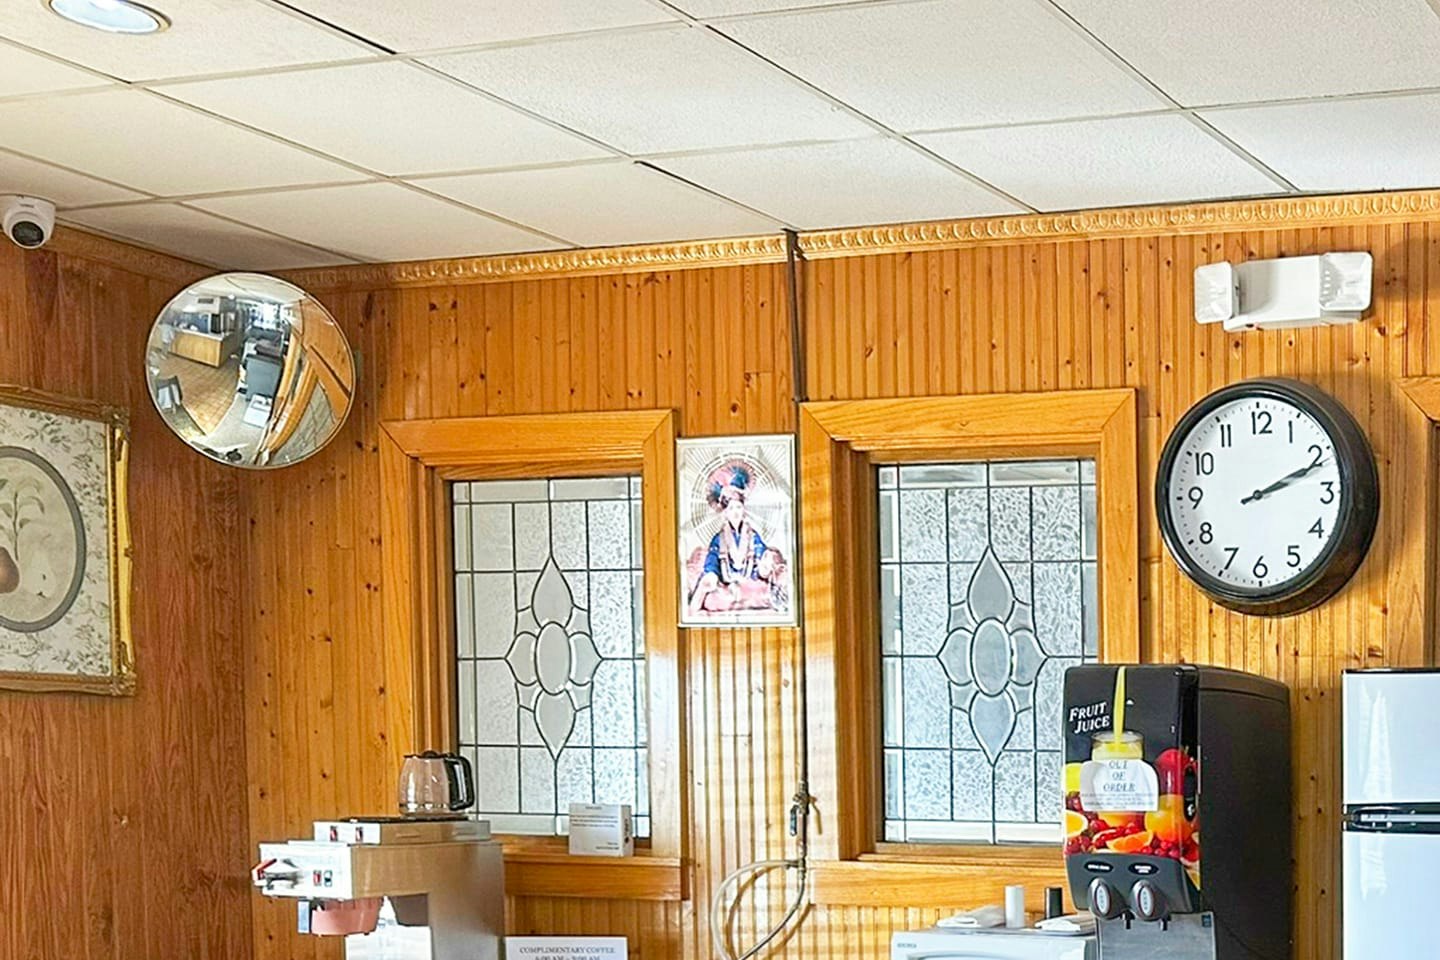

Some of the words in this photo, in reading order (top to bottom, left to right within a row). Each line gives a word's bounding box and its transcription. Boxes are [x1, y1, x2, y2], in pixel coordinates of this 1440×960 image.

[1251, 410, 1273, 435] 12
[1288, 420, 1293, 443] 1
[1220, 423, 1232, 448] 11
[1195, 452, 1214, 476] 10
[1307, 444, 1323, 467] 2
[1188, 486, 1203, 510] 9
[1319, 481, 1334, 504] 3
[1199, 522, 1213, 544] 8
[1308, 517, 1324, 538] 4
[1224, 547, 1239, 570] 7
[1252, 555, 1268, 578] 6
[1286, 545, 1301, 567] 5
[1069, 701, 1107, 722] FRUIT
[1074, 715, 1111, 734] JUICE
[519, 946, 586, 954] COMPLIMENTARY
